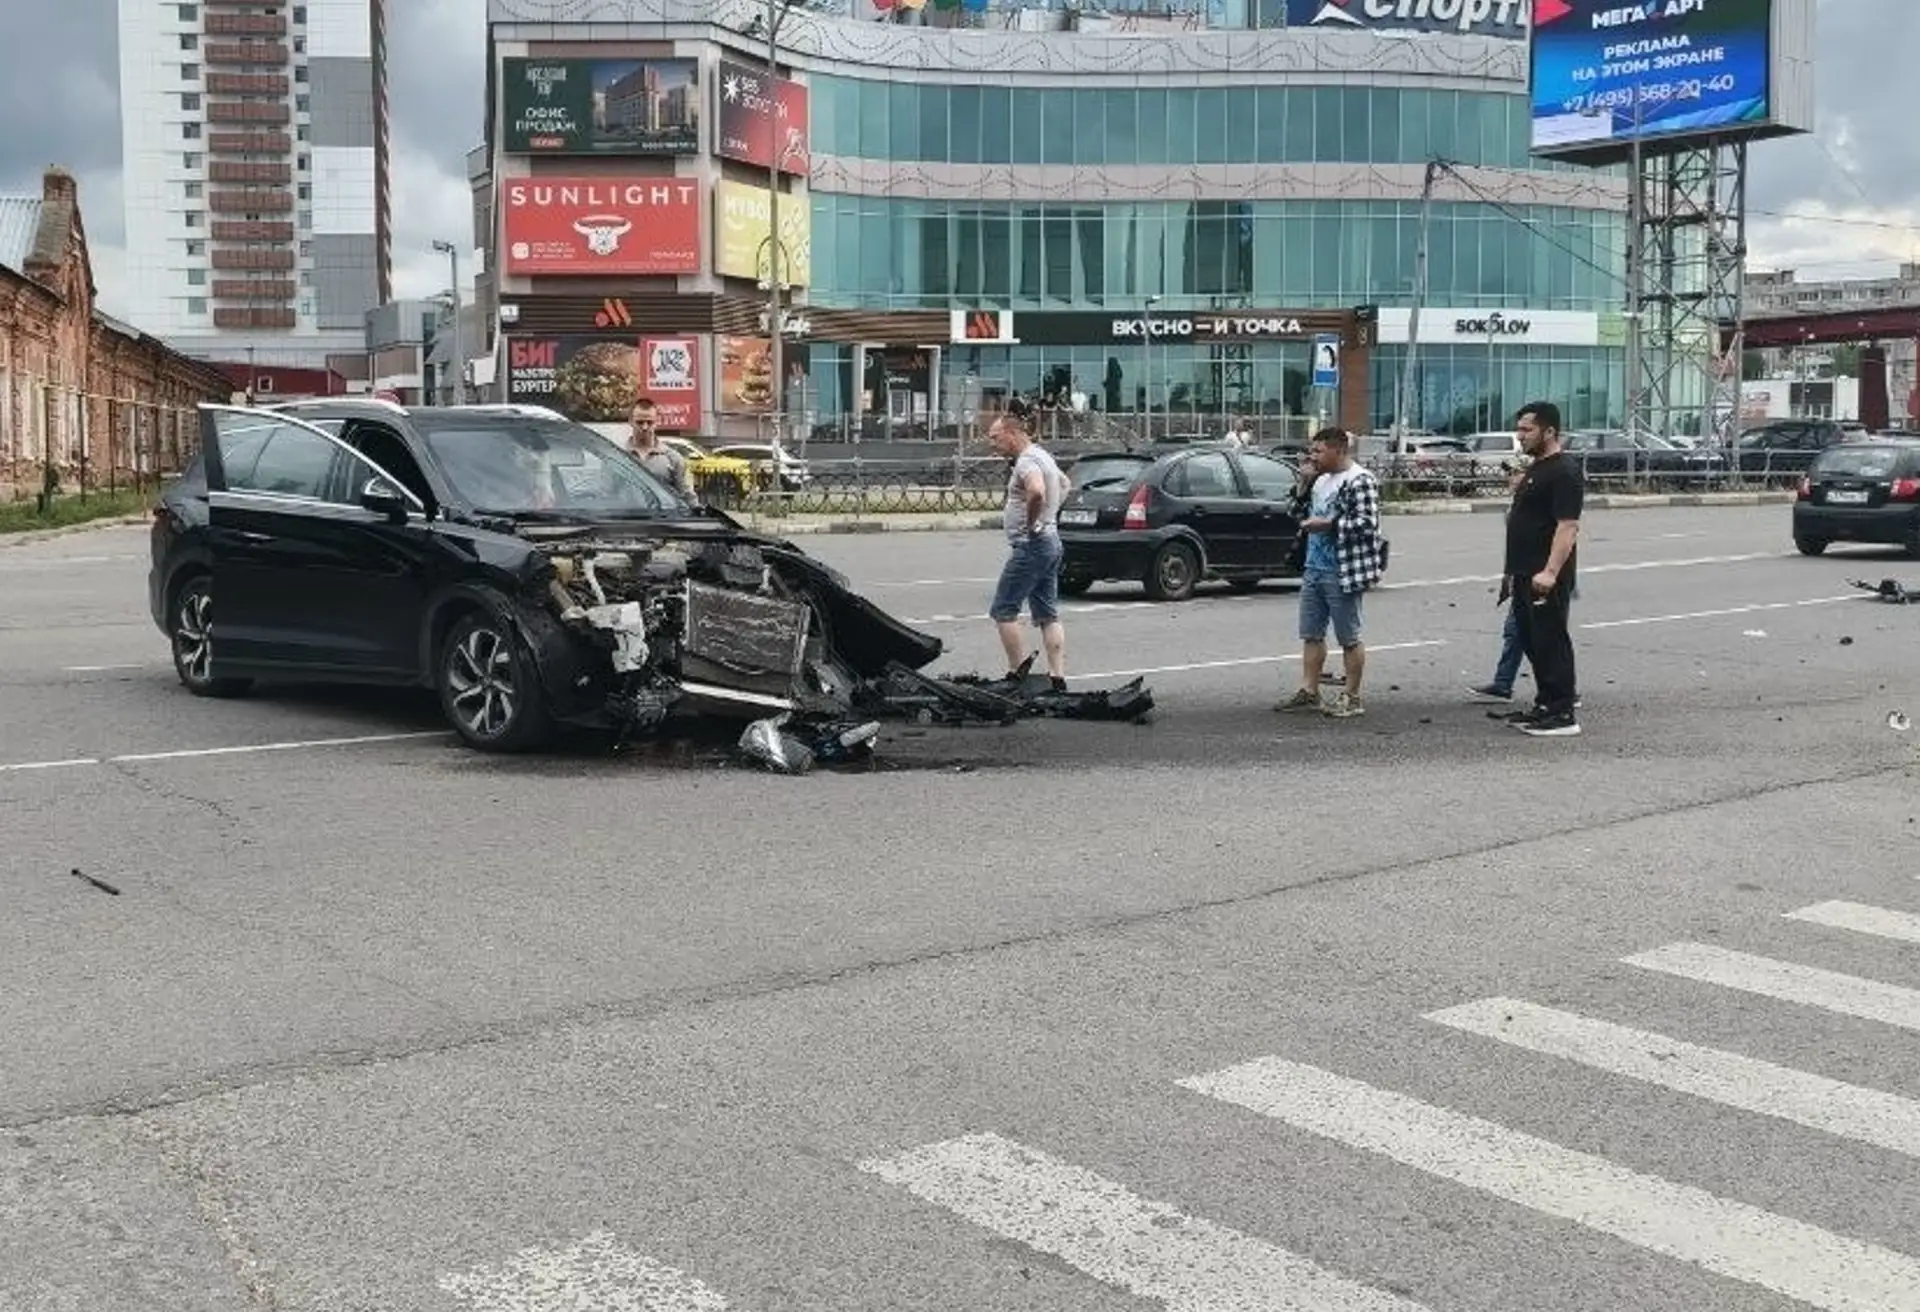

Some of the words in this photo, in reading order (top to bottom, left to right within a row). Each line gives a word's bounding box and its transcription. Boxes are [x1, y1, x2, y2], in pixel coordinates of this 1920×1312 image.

[1592, 6, 1646, 29] МЕГА
[1604, 35, 1690, 59] РЕКЛАМА
[1572, 68, 1597, 81] НА
[1602, 58, 1649, 78] ЭТОМ
[1653, 47, 1724, 70] ЭКРАНЕ
[511, 185, 696, 206] SUNLIGHT
[1112, 318, 1192, 336] ВКУСНО
[1214, 319, 1228, 335] И
[1236, 318, 1302, 334] ТОЧКА
[1455, 313, 1531, 335] SOKOLOV
[512, 340, 560, 368] БИГ
[512, 380, 558, 393] БУРГЕР
